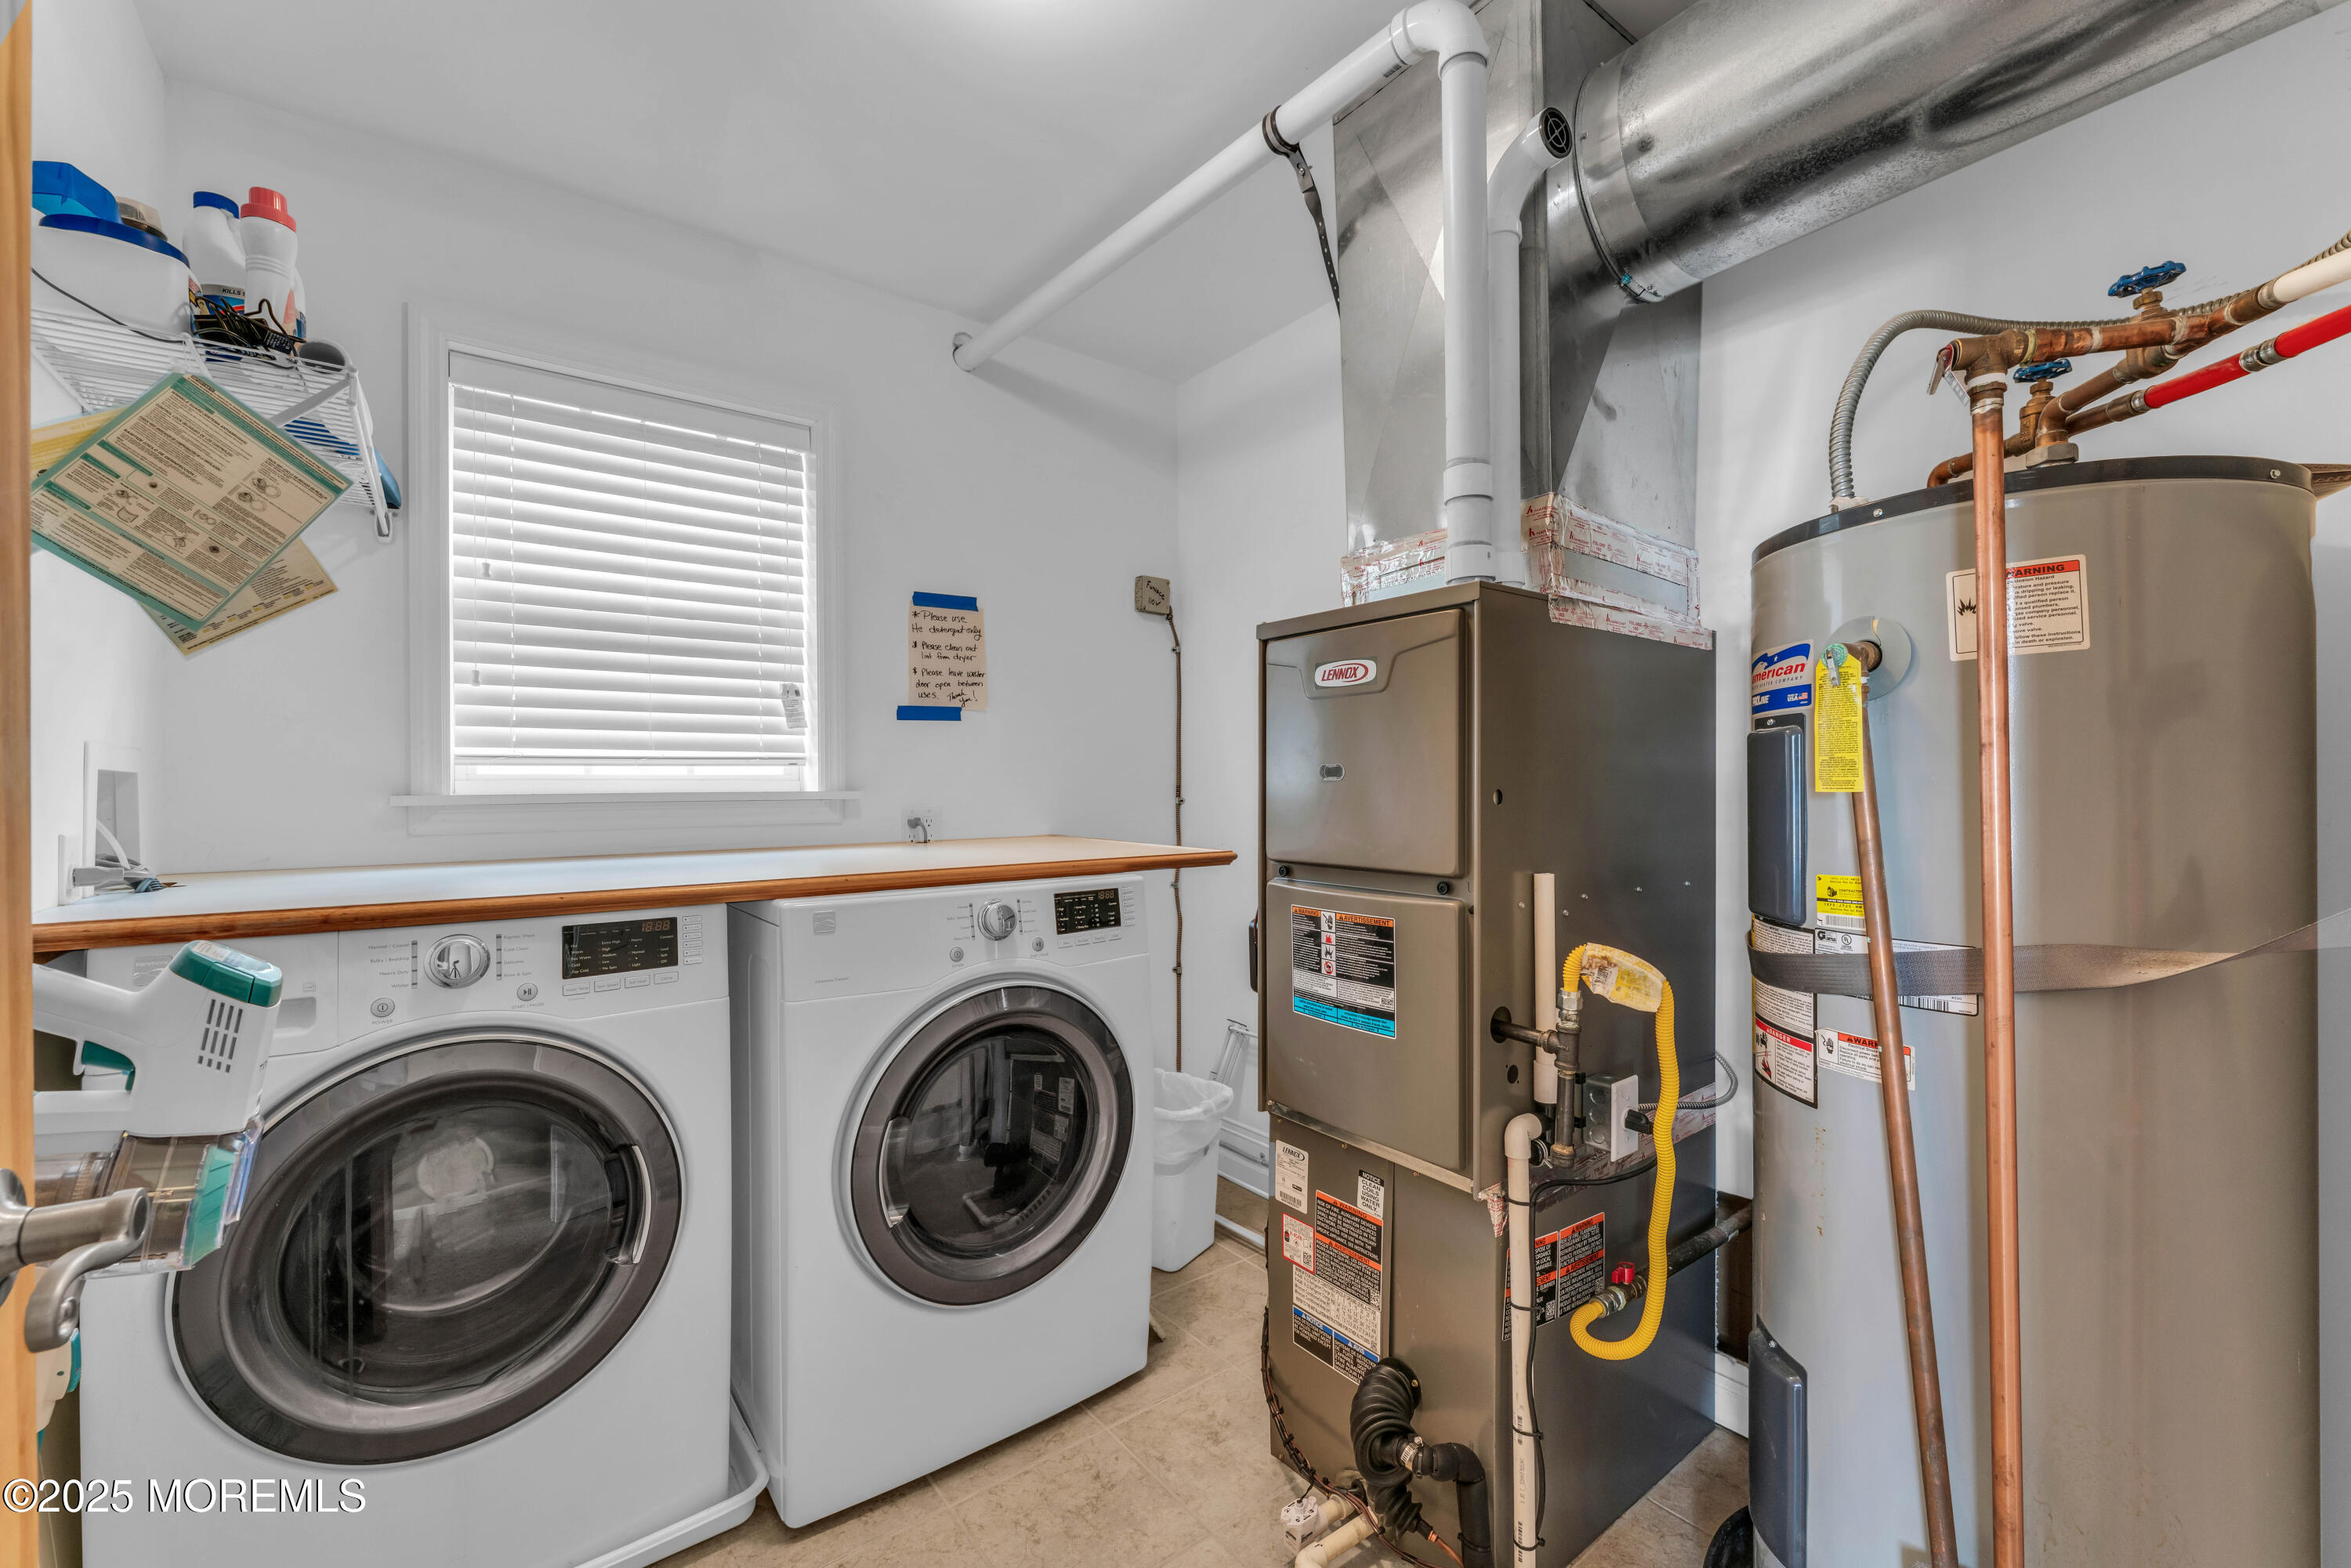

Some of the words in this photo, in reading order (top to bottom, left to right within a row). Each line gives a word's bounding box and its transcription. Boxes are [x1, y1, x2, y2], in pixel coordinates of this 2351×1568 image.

[921, 610, 947, 621] Please
[922, 641, 941, 650] Please
[953, 653, 977, 663] dryer
[922, 668, 943, 677] Please
[949, 668, 963, 677] leave
[1321, 666, 1360, 682] LENNOX
[1299, 908, 1318, 917] WARNING
[1344, 916, 1389, 926] AVERTISSEMENT
[1770, 1028, 1791, 1043] DANGER
[1282, 1146, 1301, 1161] LENNOX
[1363, 1171, 1381, 1184] NOTICE
[1362, 1179, 1381, 1192] CLEAN
[1363, 1185, 1379, 1197] COILS
[1360, 1195, 1380, 1208] WATER
[1362, 1191, 1379, 1202] USING
[1339, 1201, 1367, 1219] WARNING
[1363, 1202, 1377, 1212] ONLY.
[1317, 1209, 1328, 1219] SHALL
[1342, 1222, 1362, 1235] INSTALLED
[1360, 1219, 1376, 1231] DEVICES
[1575, 1219, 1592, 1229] WARNING
[1336, 1224, 1348, 1233] OTHER
[1360, 1224, 1376, 1237] SOURCES
[1334, 1243, 1369, 1264] AVERTISSEMENT
[1541, 1256, 1551, 1265] LOCAL
[1570, 1252, 1598, 1270] AVERTISSEMENT
[1306, 1316, 1323, 1330] NOTICE
[1353, 1343, 1364, 1355] AVIS
